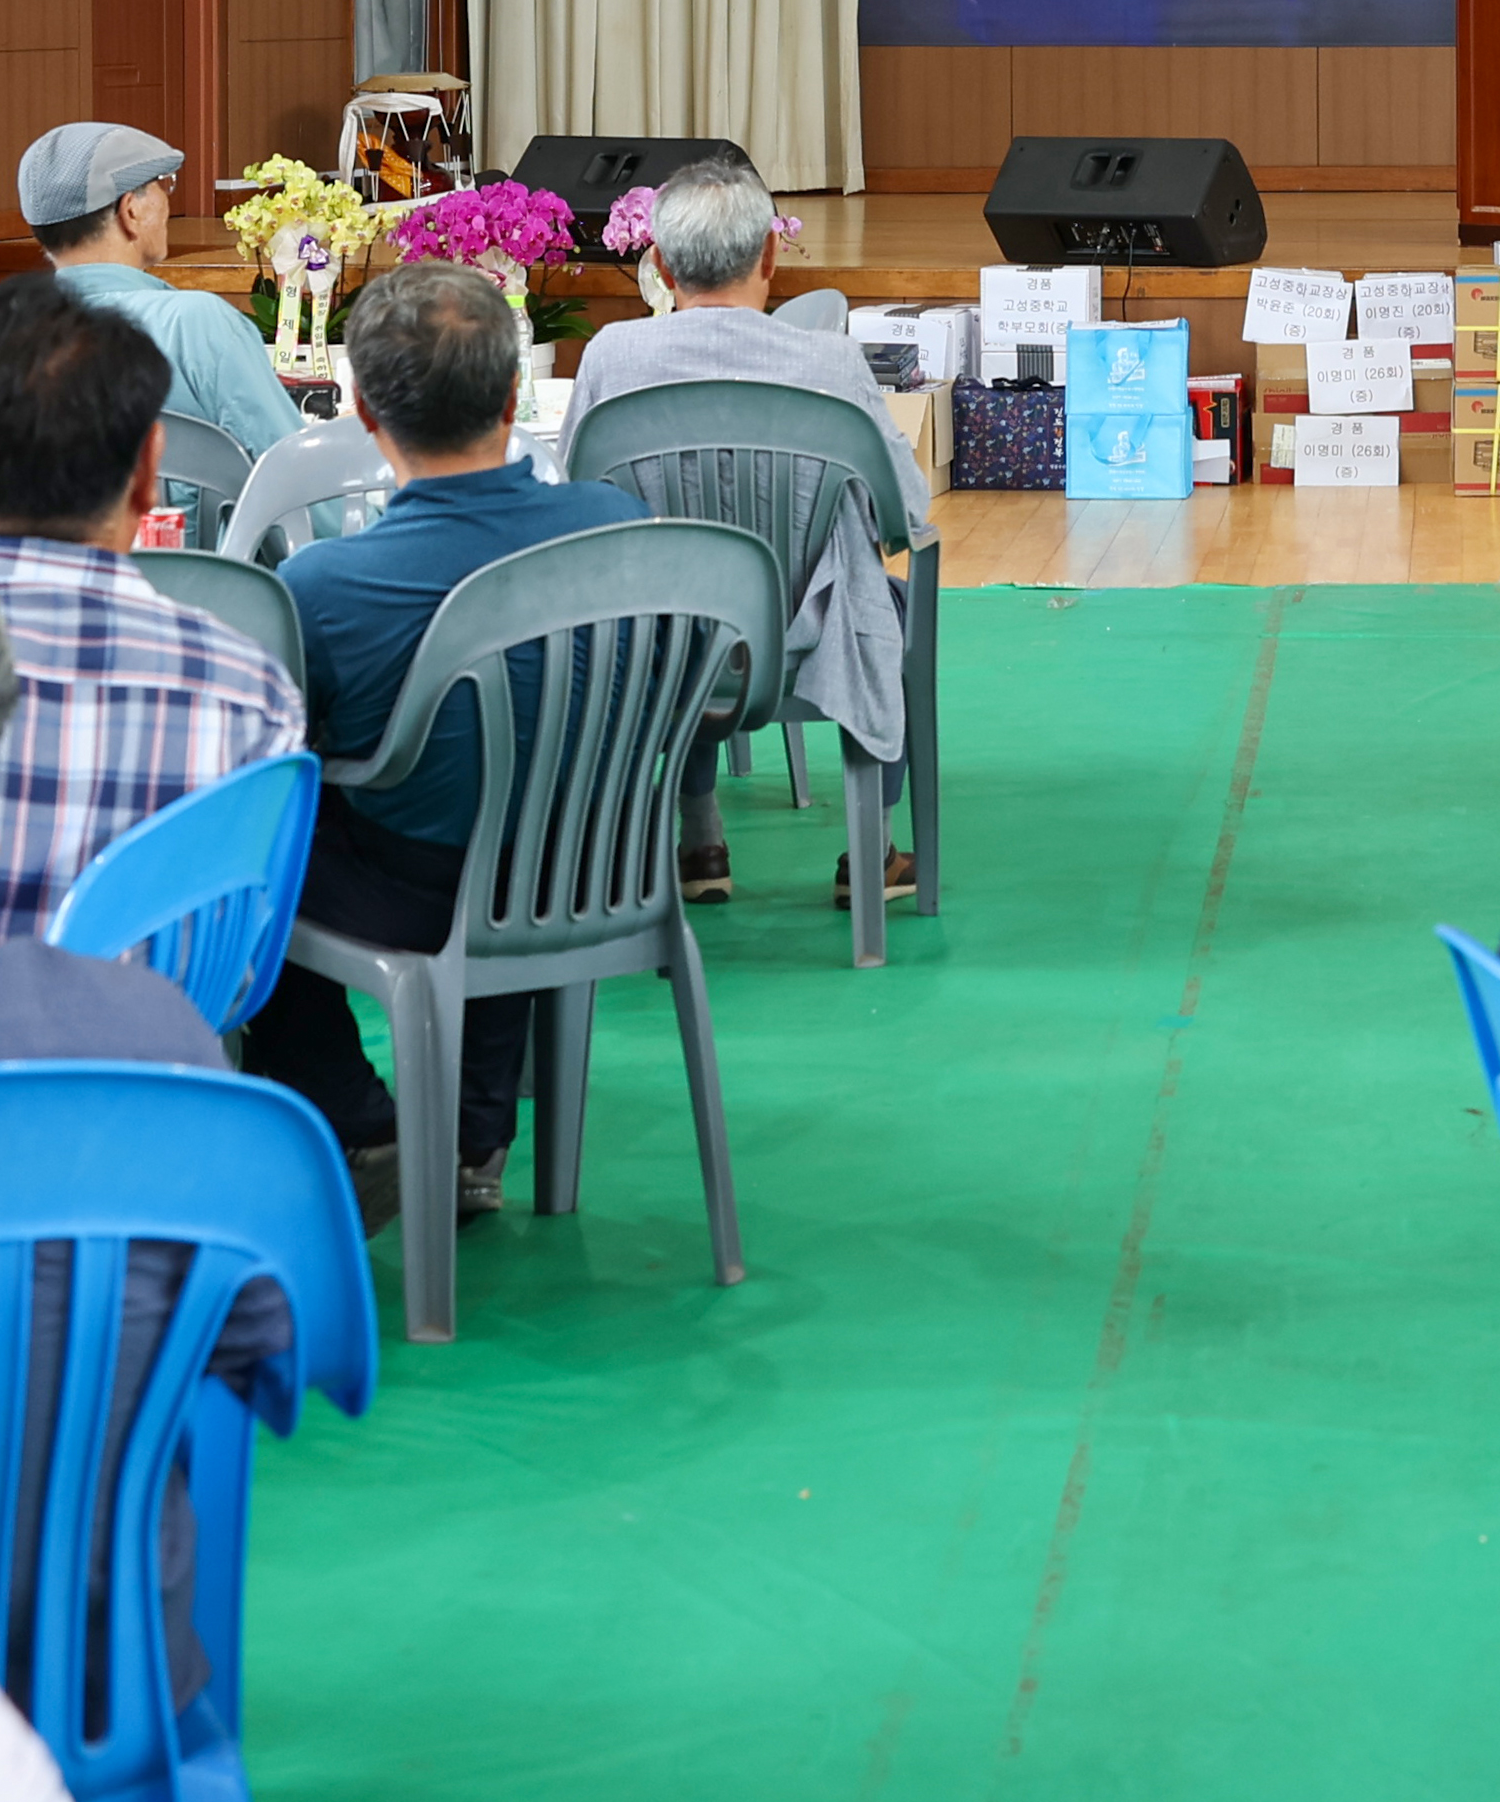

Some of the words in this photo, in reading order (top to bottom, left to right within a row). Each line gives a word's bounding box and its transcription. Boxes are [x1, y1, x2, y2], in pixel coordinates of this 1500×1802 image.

[1027, 278, 1052, 290] 경품
[1254, 275, 1348, 299] 고성중학교장상
[1003, 299, 1068, 312] 고성중학교
[1257, 298, 1295, 314] 박윤준
[1302, 304, 1341, 322] (20회)
[1365, 305, 1404, 319] 이명진
[1412, 303, 1451, 317] (20회)
[998, 321, 1067, 334] 학부모회(증
[1284, 323, 1307, 338] (증)
[1398, 326, 1421, 339] (증)
[1317, 369, 1356, 383] 이명미
[1364, 366, 1404, 380] (26회)
[1350, 389, 1373, 404] (증)
[1304, 444, 1343, 457] 이명미
[1351, 444, 1391, 458] (26회)
[1335, 465, 1359, 479] (증)
